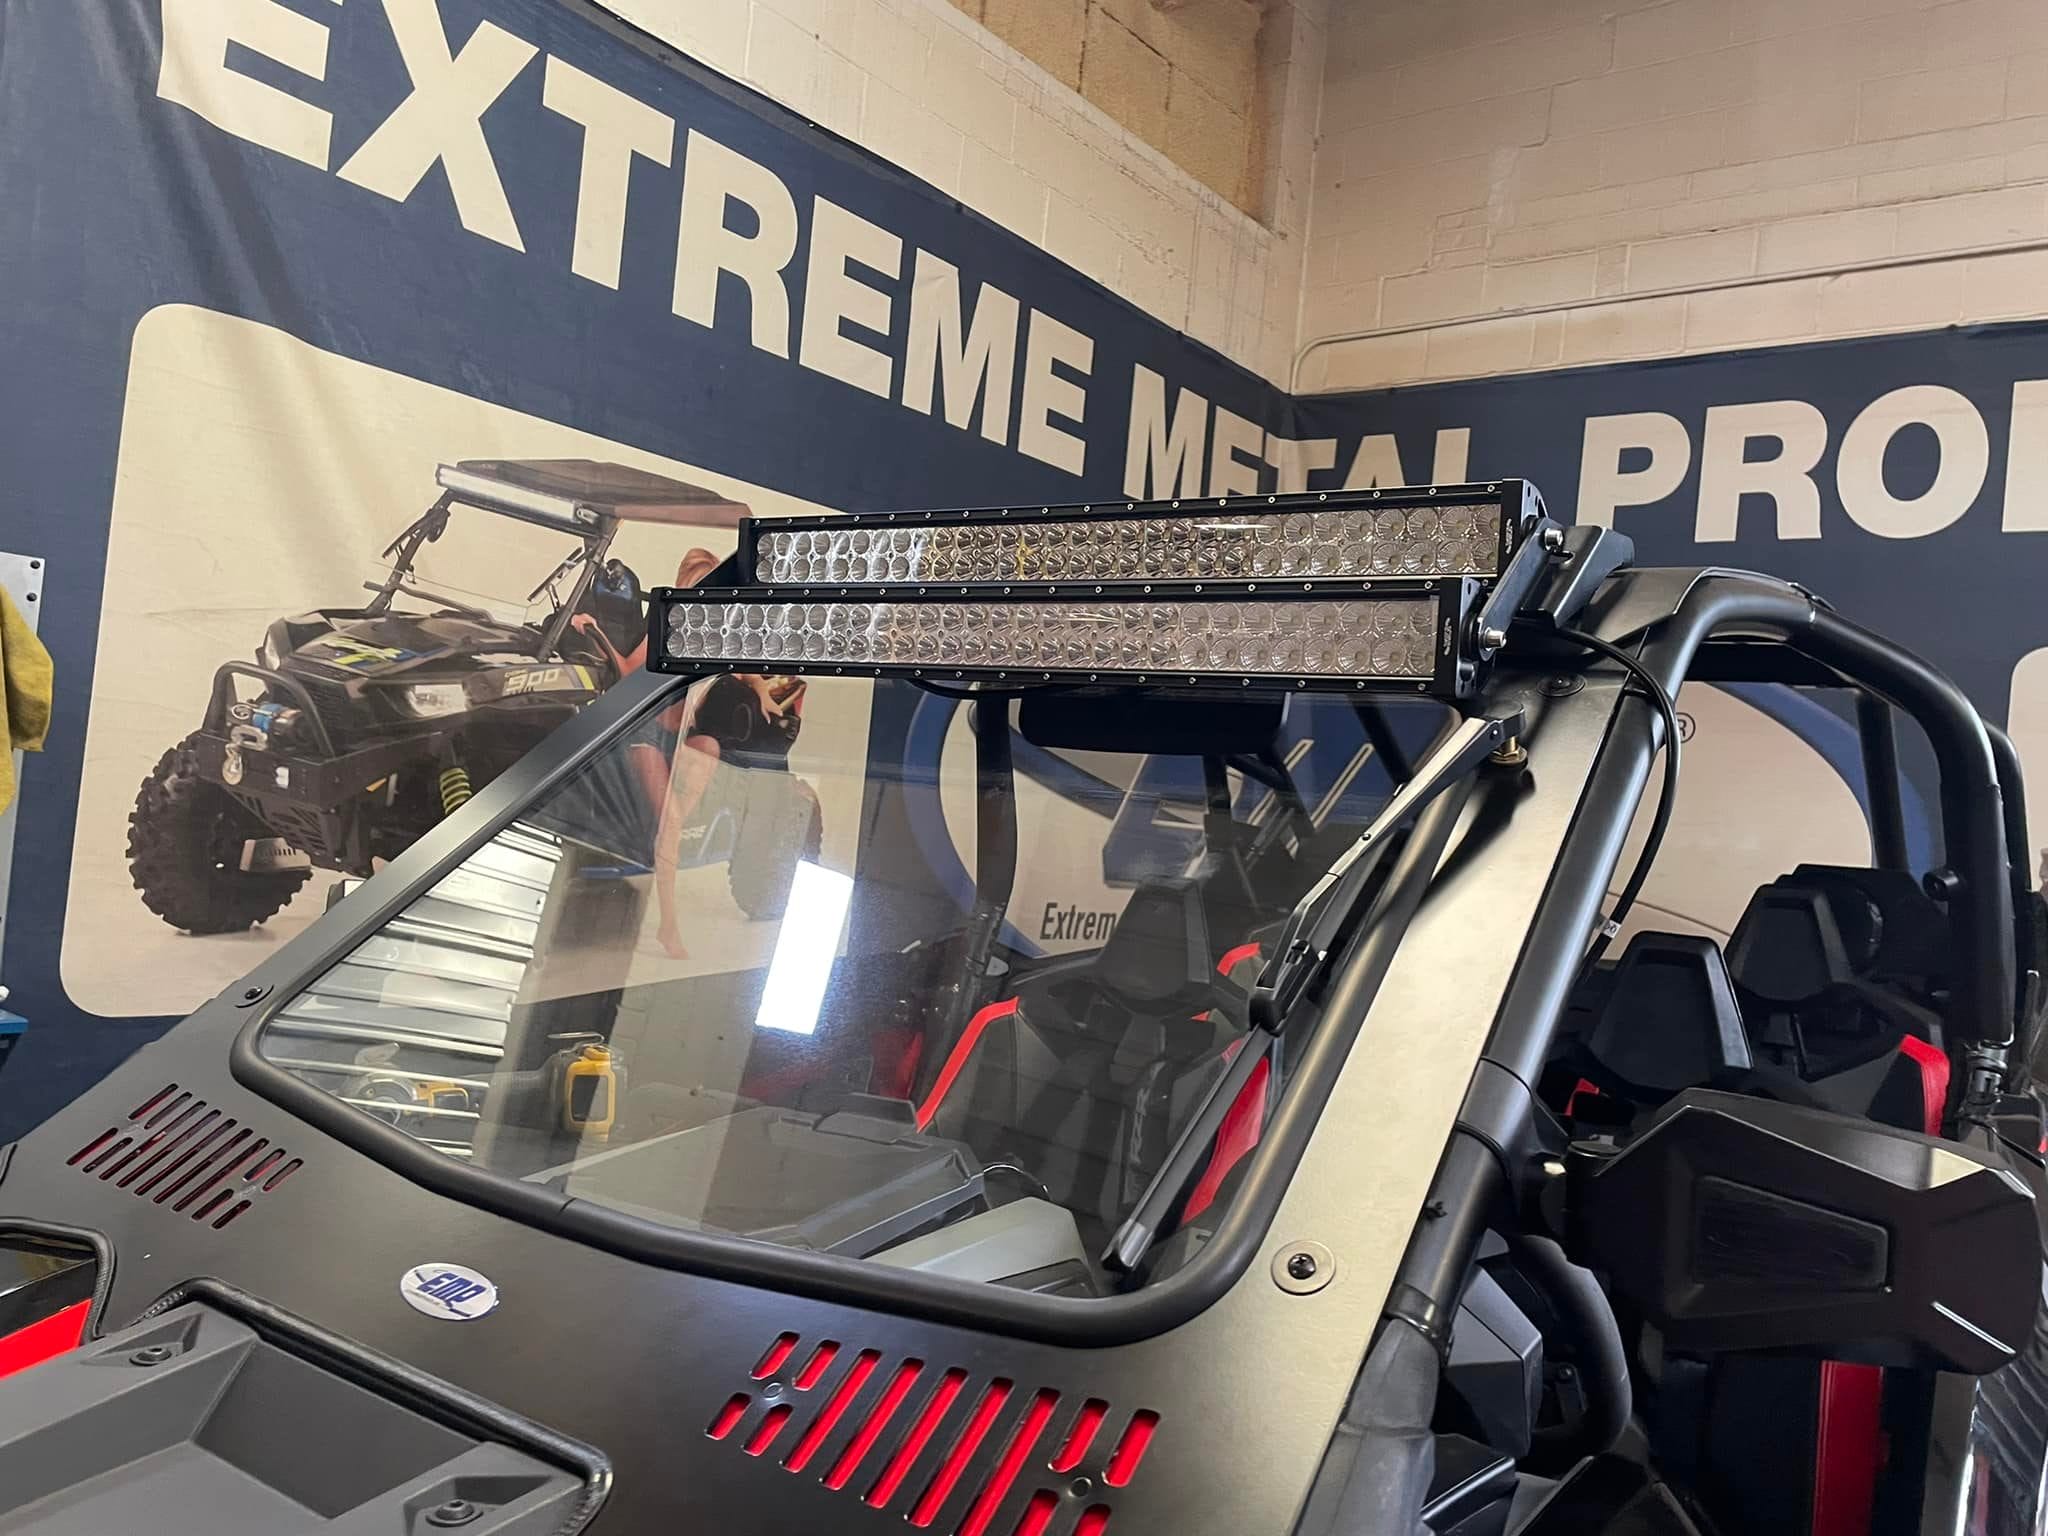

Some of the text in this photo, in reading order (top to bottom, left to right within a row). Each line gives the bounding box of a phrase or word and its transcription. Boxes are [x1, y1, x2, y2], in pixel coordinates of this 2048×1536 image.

[156, 0, 1095, 477] EXTREME
[1574, 378, 2048, 543] PRO
[1039, 902, 1117, 940] Extrem
